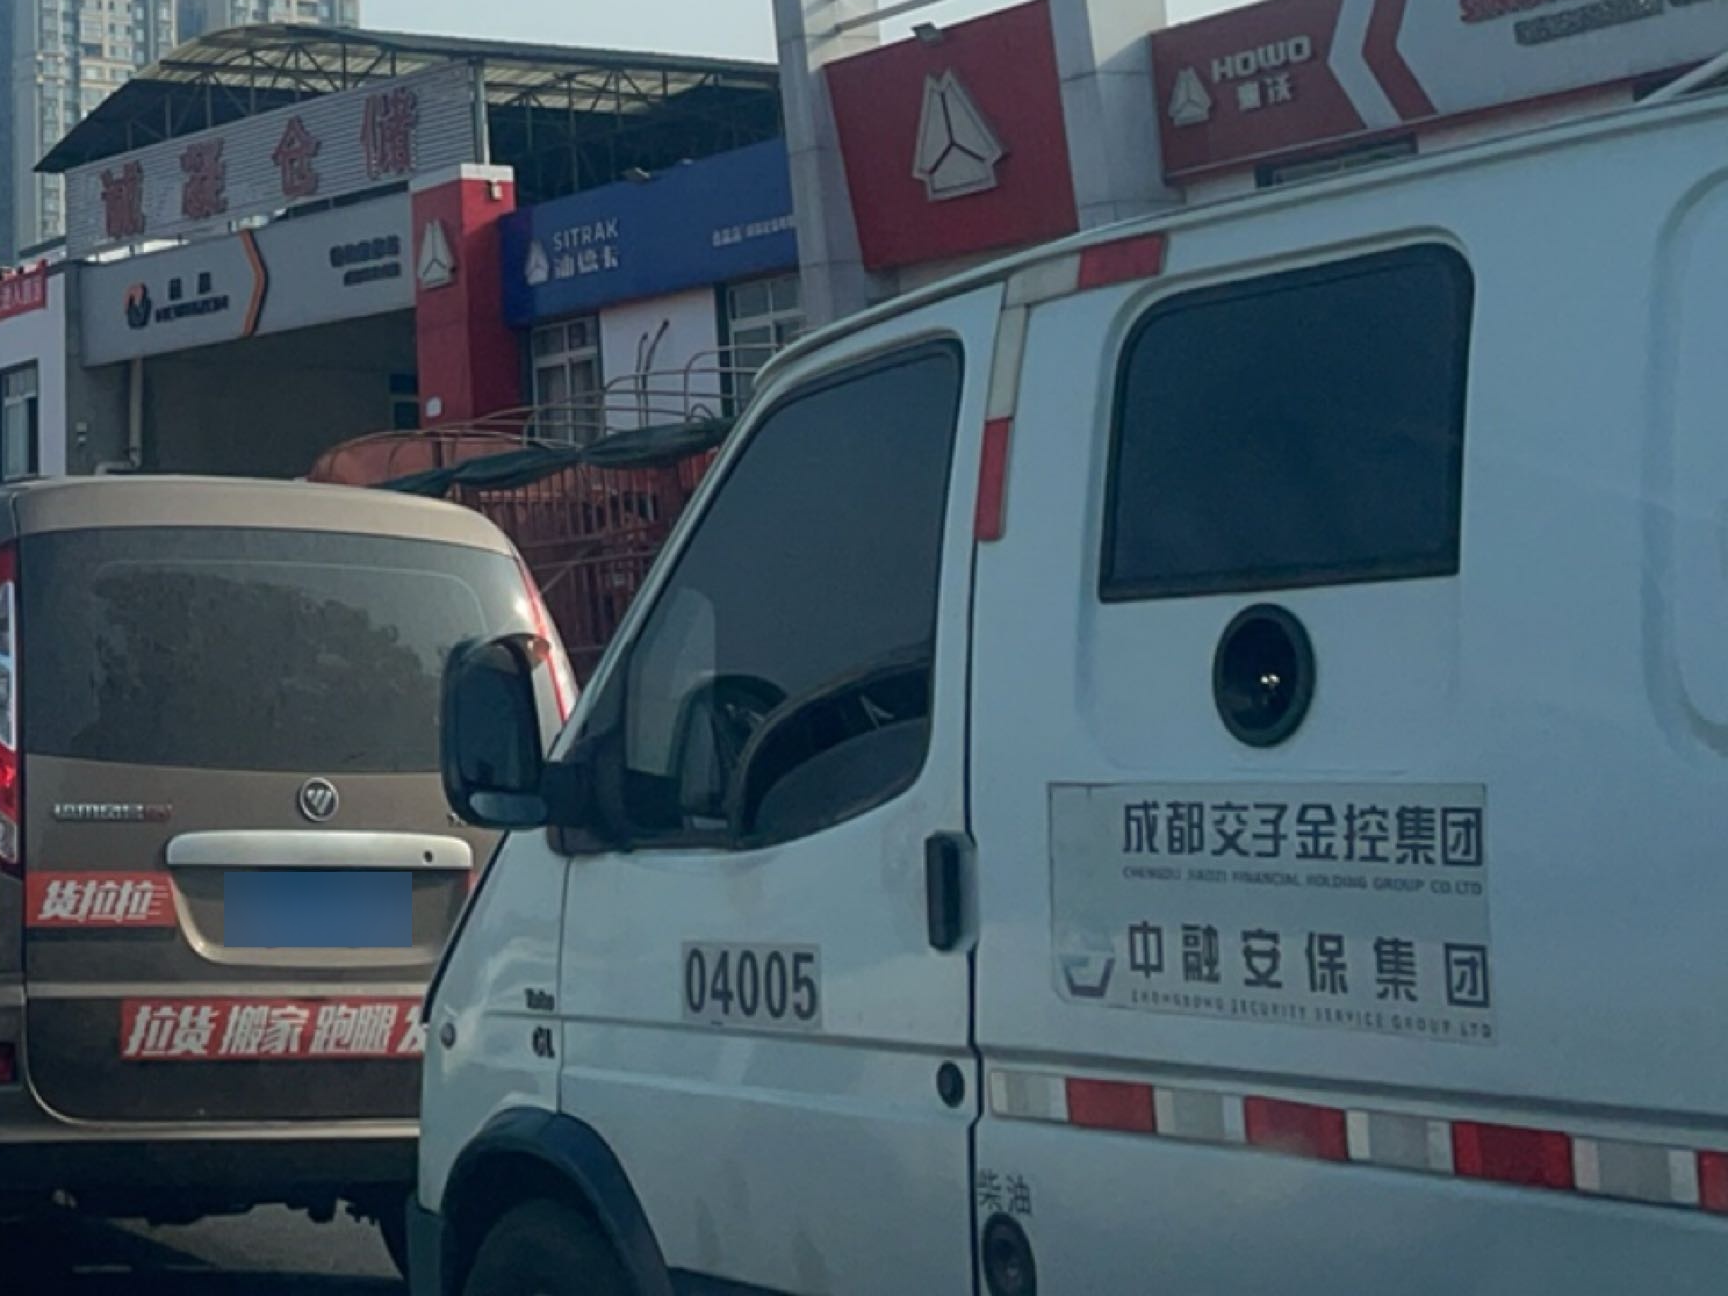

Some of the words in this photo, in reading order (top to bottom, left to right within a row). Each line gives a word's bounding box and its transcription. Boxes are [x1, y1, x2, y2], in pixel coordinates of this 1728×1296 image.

[1210, 35, 1311, 83] HOWO
[553, 217, 620, 251] SITRAK
[1122, 800, 1484, 866] 成都交子金控集团
[38, 879, 158, 922] 货拉拉
[1123, 866, 1181, 881] CHENGDU
[1231, 870, 1302, 887] FINANCIAL
[1306, 873, 1368, 890] HOLDING
[1373, 876, 1425, 892] GROUP
[685, 947, 817, 1021] 04005
[1128, 921, 1490, 1008] 中融安保集团
[124, 1005, 220, 1055] 拉货
[218, 1004, 310, 1053] 搬家
[309, 1003, 398, 1052] 跑腿
[1231, 998, 1306, 1020] SECURITY
[1315, 1006, 1383, 1029] SERVICE
[1390, 1014, 1450, 1035] GROUP
